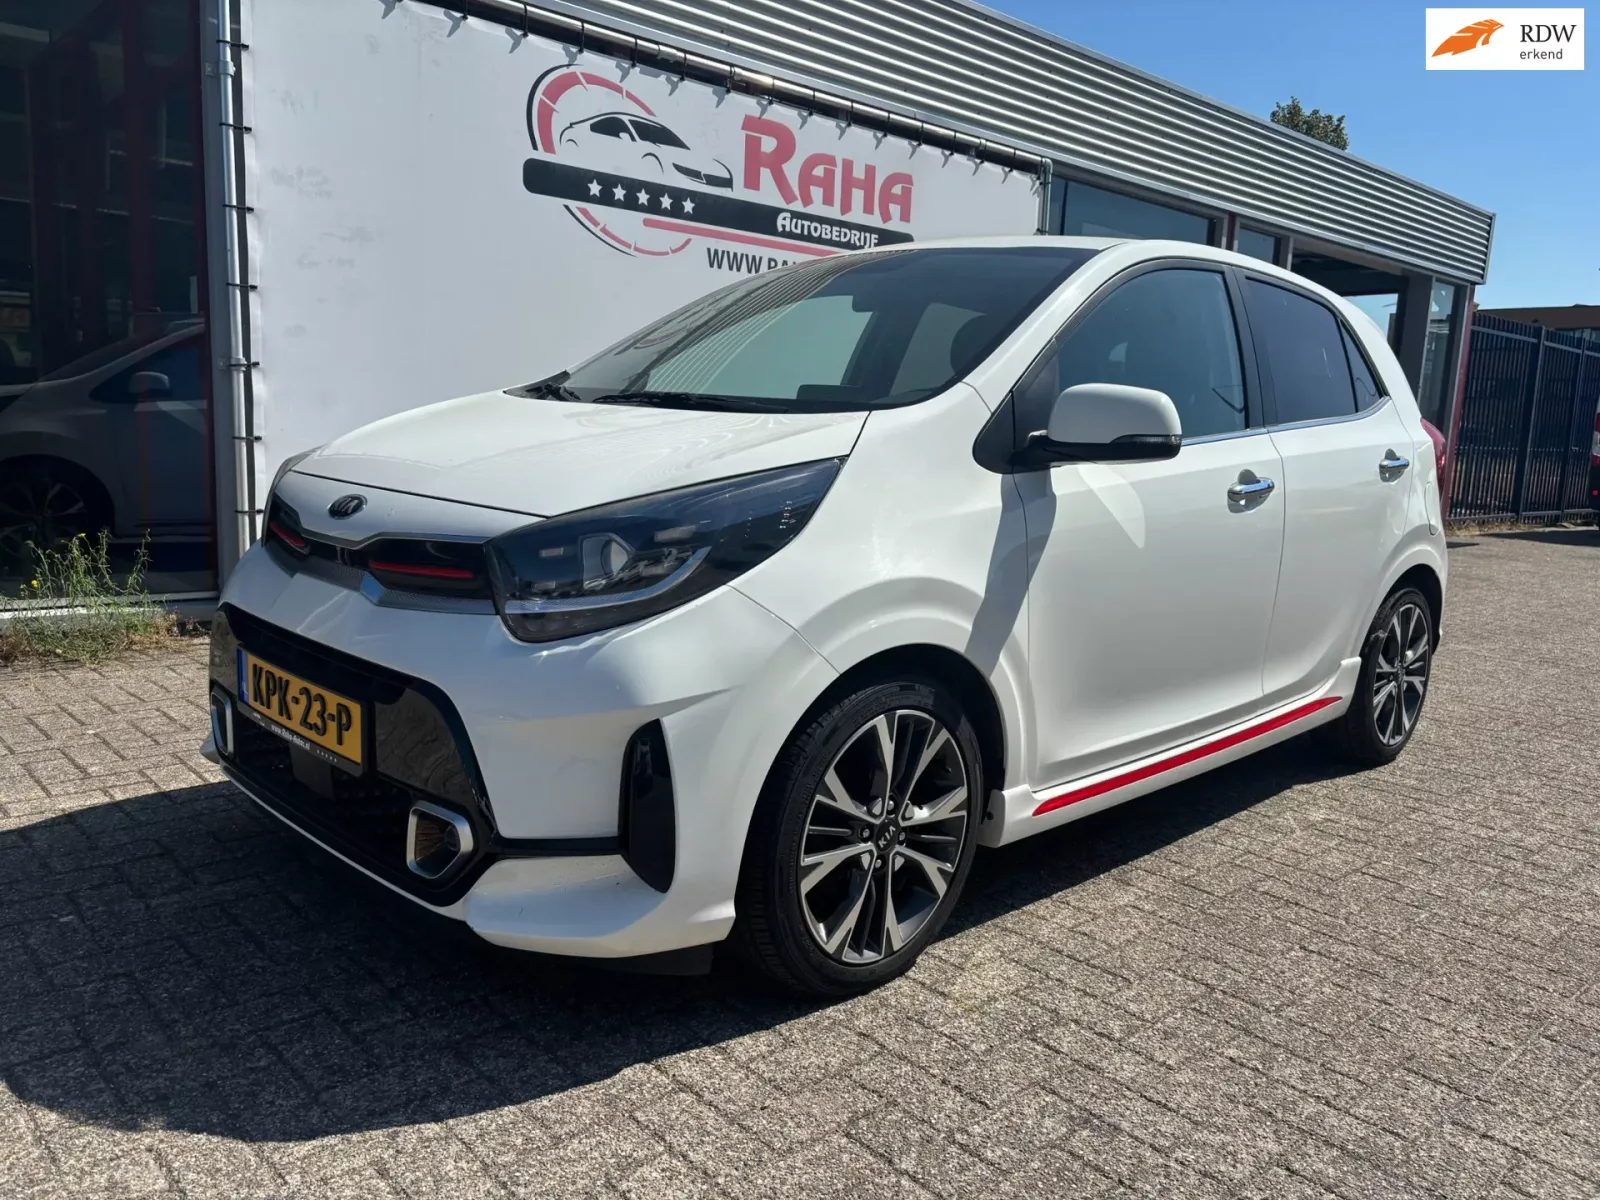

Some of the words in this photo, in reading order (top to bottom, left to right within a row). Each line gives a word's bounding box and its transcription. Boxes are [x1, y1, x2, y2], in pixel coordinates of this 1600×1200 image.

[741, 114, 914, 225] RAHA
[252, 663, 352, 747] KPK-23-P
[877, 825, 897, 849] KIA
